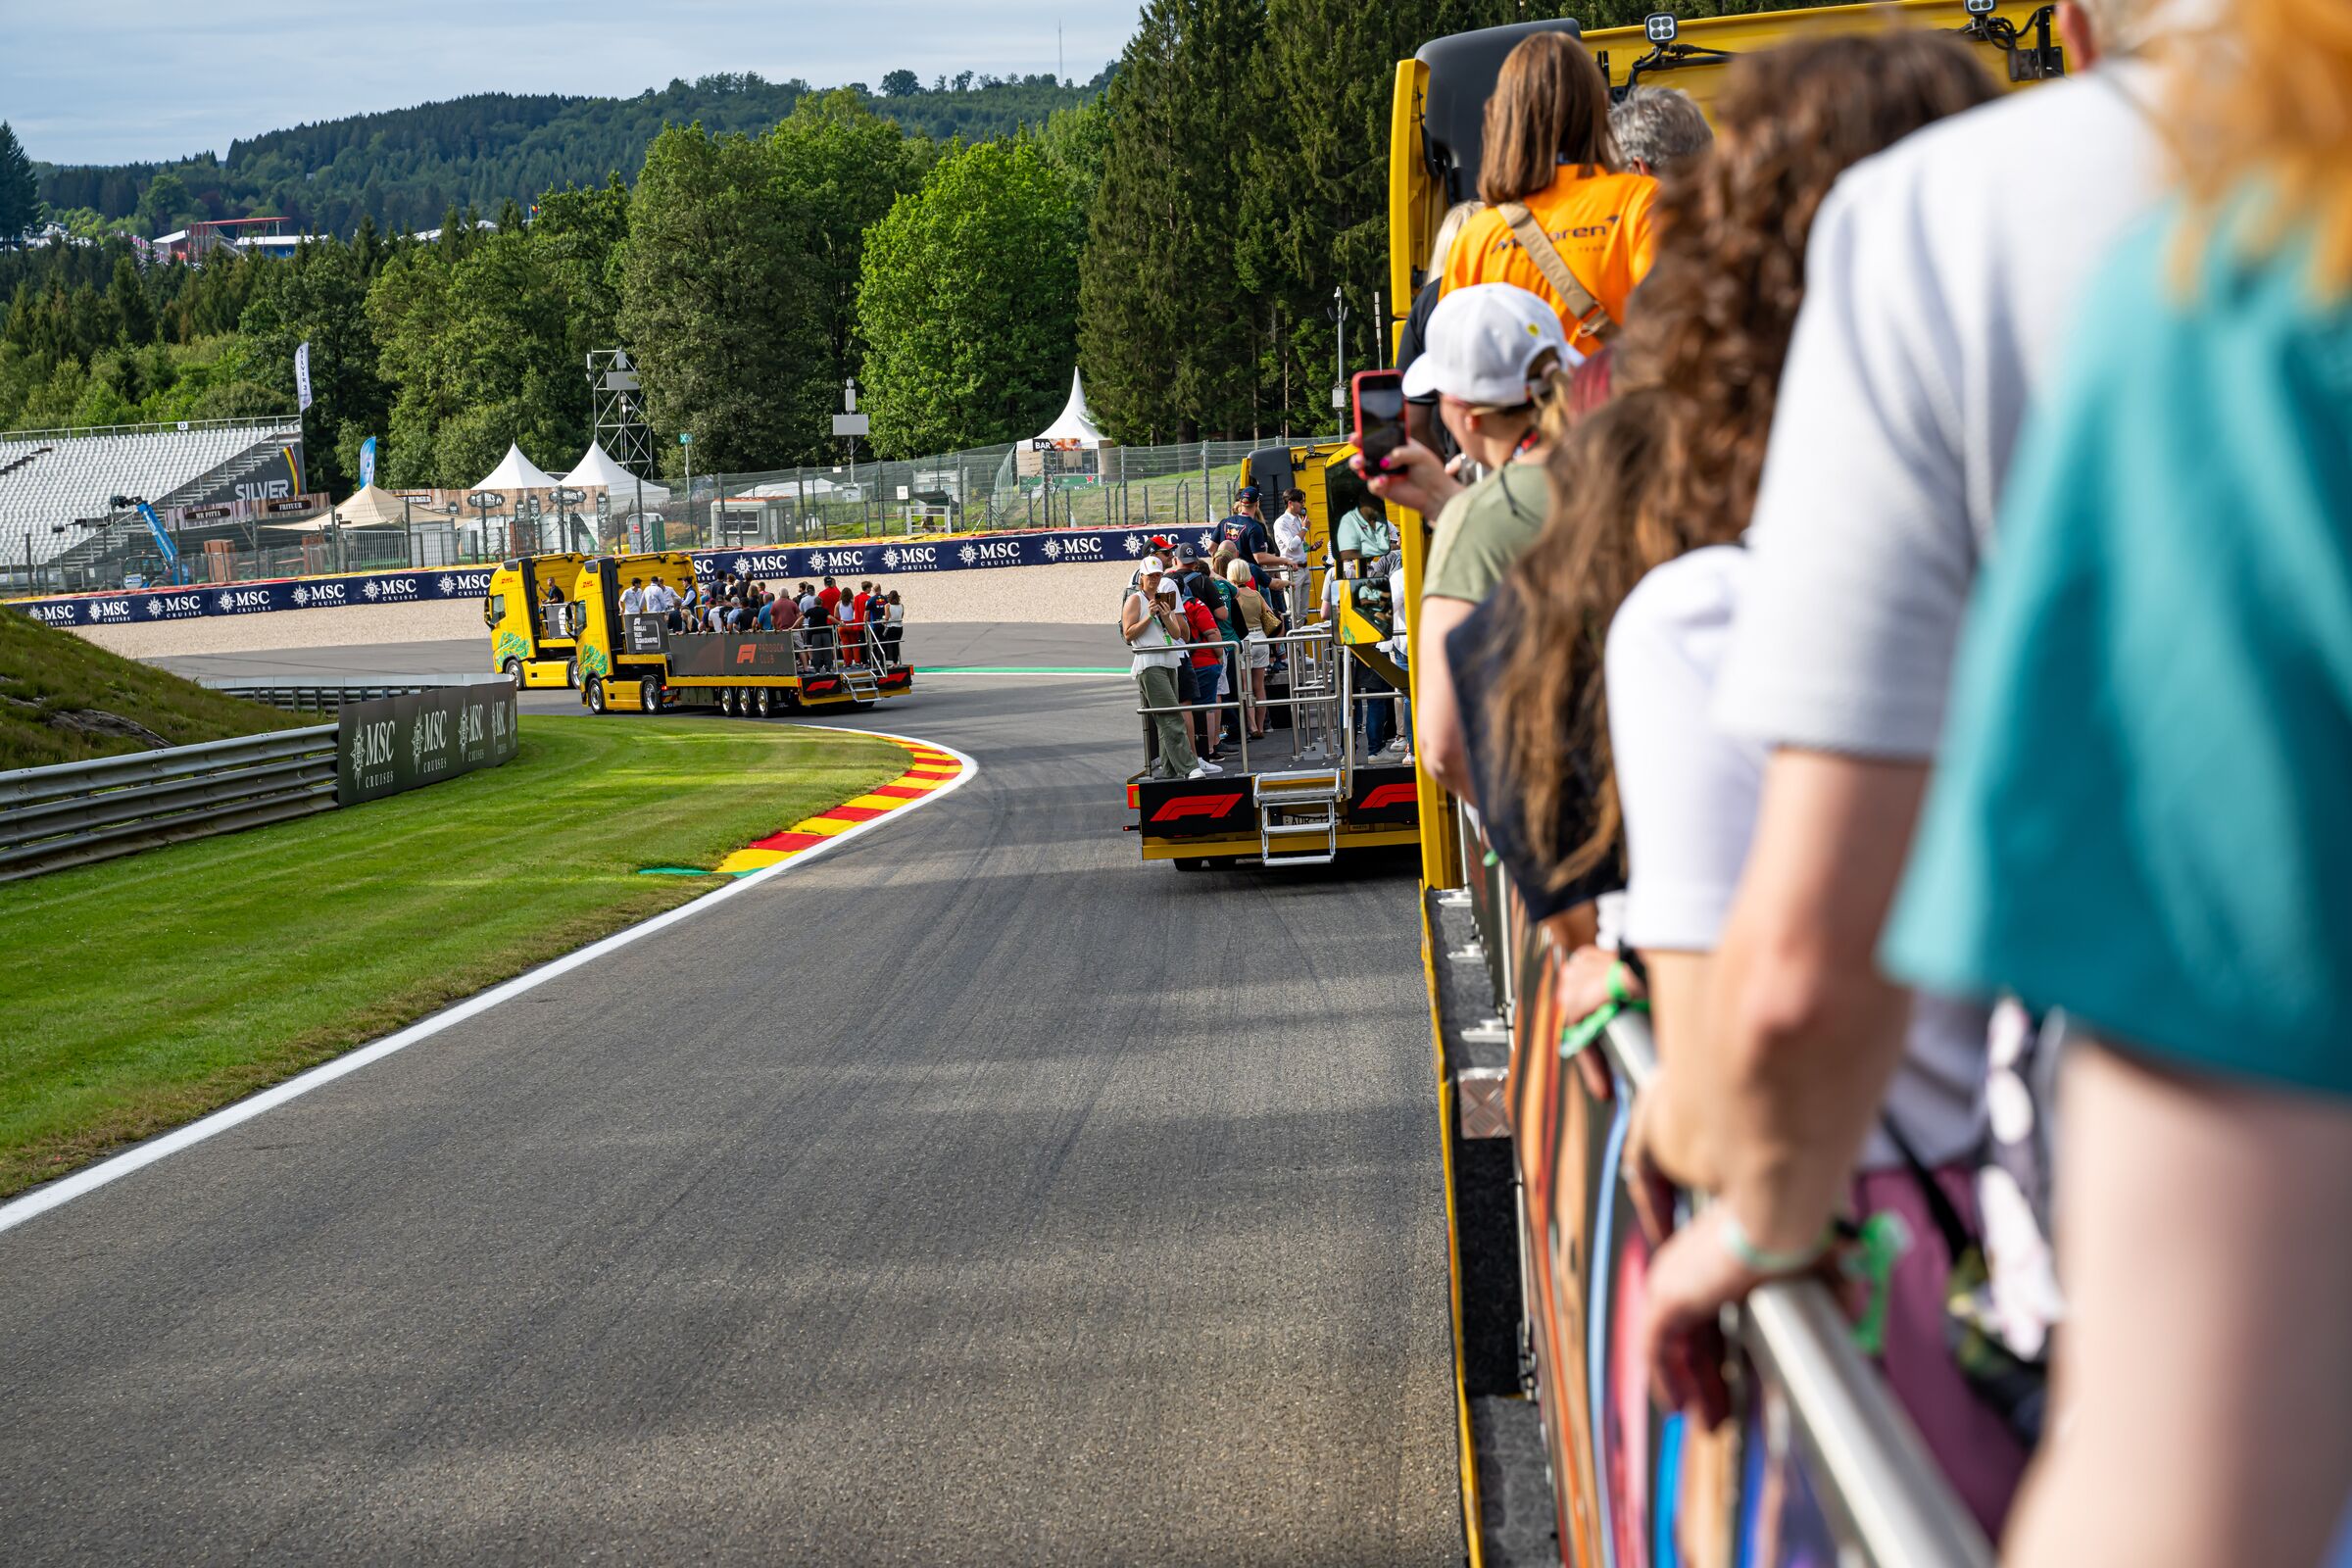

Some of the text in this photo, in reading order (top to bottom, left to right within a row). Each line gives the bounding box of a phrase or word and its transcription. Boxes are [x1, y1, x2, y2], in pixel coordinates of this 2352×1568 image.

[235, 480, 289, 501] SILVER
[980, 542, 1020, 559] MSC
[1063, 537, 1102, 554] MSC
[828, 551, 863, 567] MSC
[901, 547, 936, 563] MSC
[694, 560, 714, 574] SC
[752, 556, 788, 571] MSC
[381, 579, 416, 594] MSC
[457, 574, 490, 589] MSC
[236, 591, 270, 606] MSC
[310, 584, 345, 601] MSC
[102, 601, 128, 615] MSC
[166, 596, 200, 611] MSC
[43, 605, 74, 620] MSC
[424, 710, 447, 753] MSC
[469, 704, 484, 743] MSC
[367, 720, 396, 766] MSC
[423, 758, 447, 773] CRUISES
[366, 770, 394, 789] CRUISES
